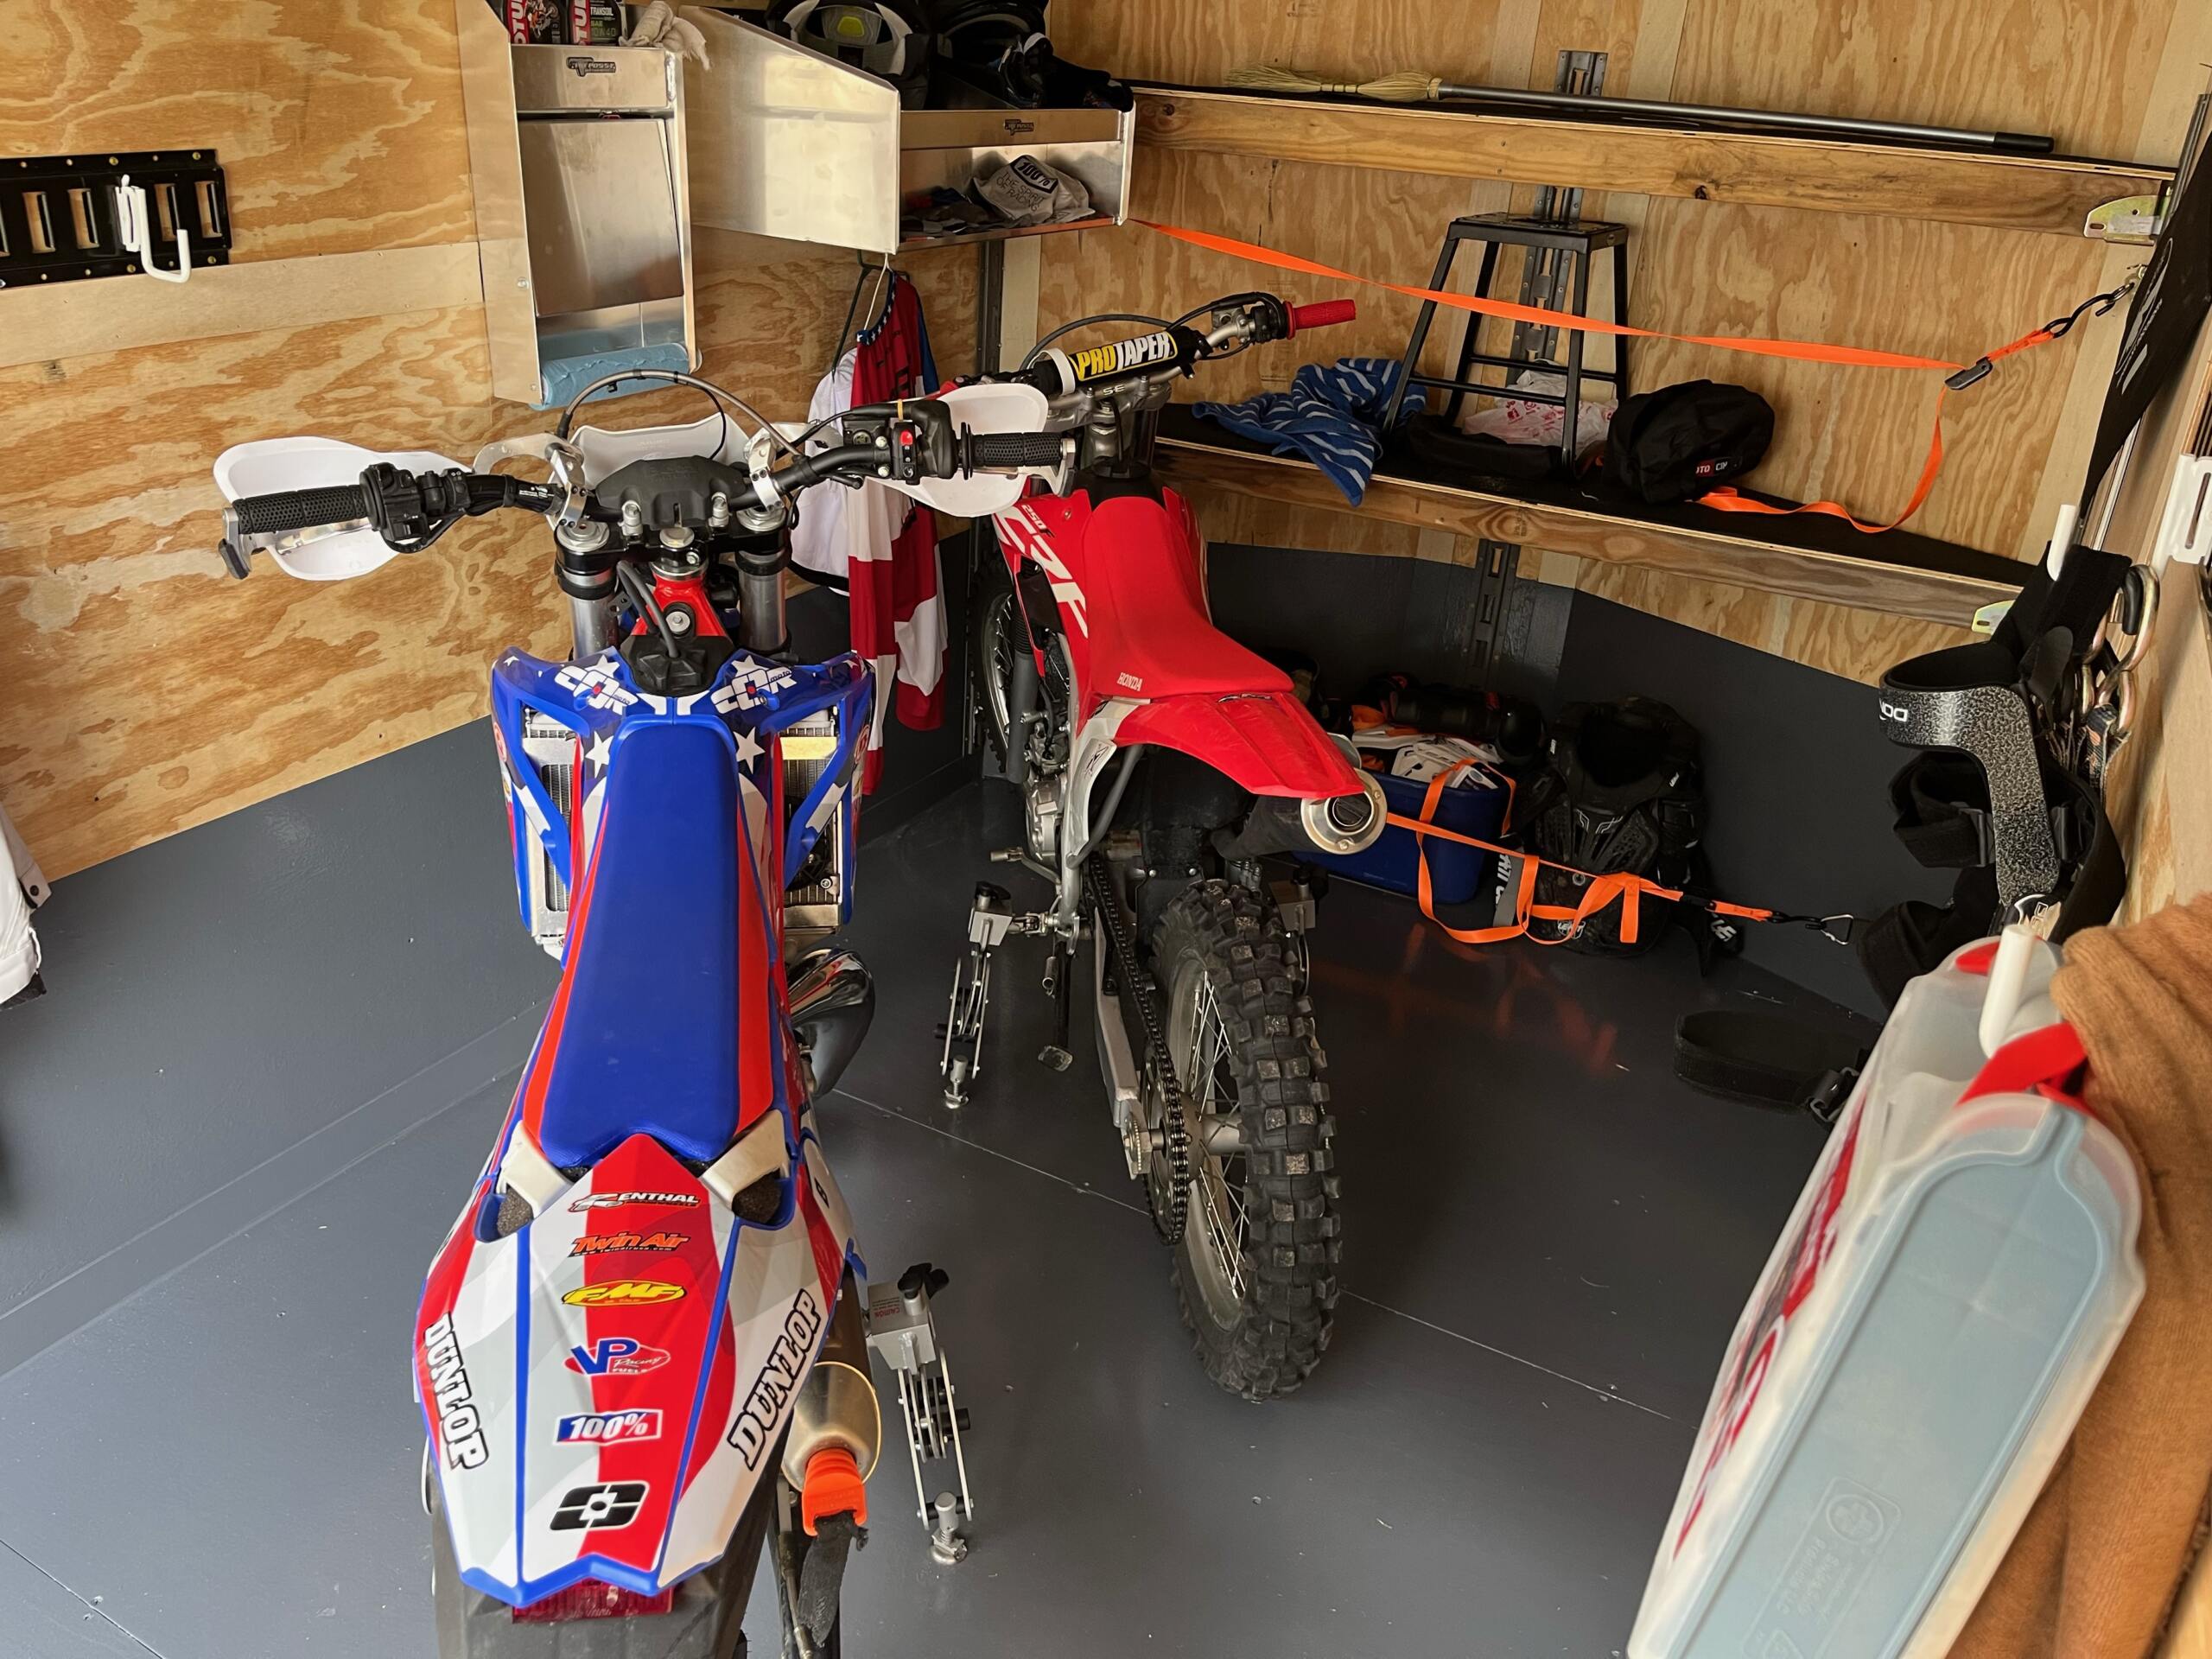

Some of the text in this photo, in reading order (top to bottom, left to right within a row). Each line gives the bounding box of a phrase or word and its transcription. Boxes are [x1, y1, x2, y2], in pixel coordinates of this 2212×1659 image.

[1018, 162, 1051, 187] 100%
[996, 176, 1038, 212] OF RACING
[1002, 172, 1046, 208] THE SPIRIT
[1116, 671, 1143, 692] HONDA
[574, 1232, 689, 1252] Twin Air
[564, 1283, 683, 1304] FMF
[570, 1338, 639, 1376] VP
[613, 1356, 663, 1368] Racing
[423, 1311, 489, 1470] DUNLOP
[727, 1288, 821, 1471] DUNLOP
[569, 1413, 648, 1441] 100%
